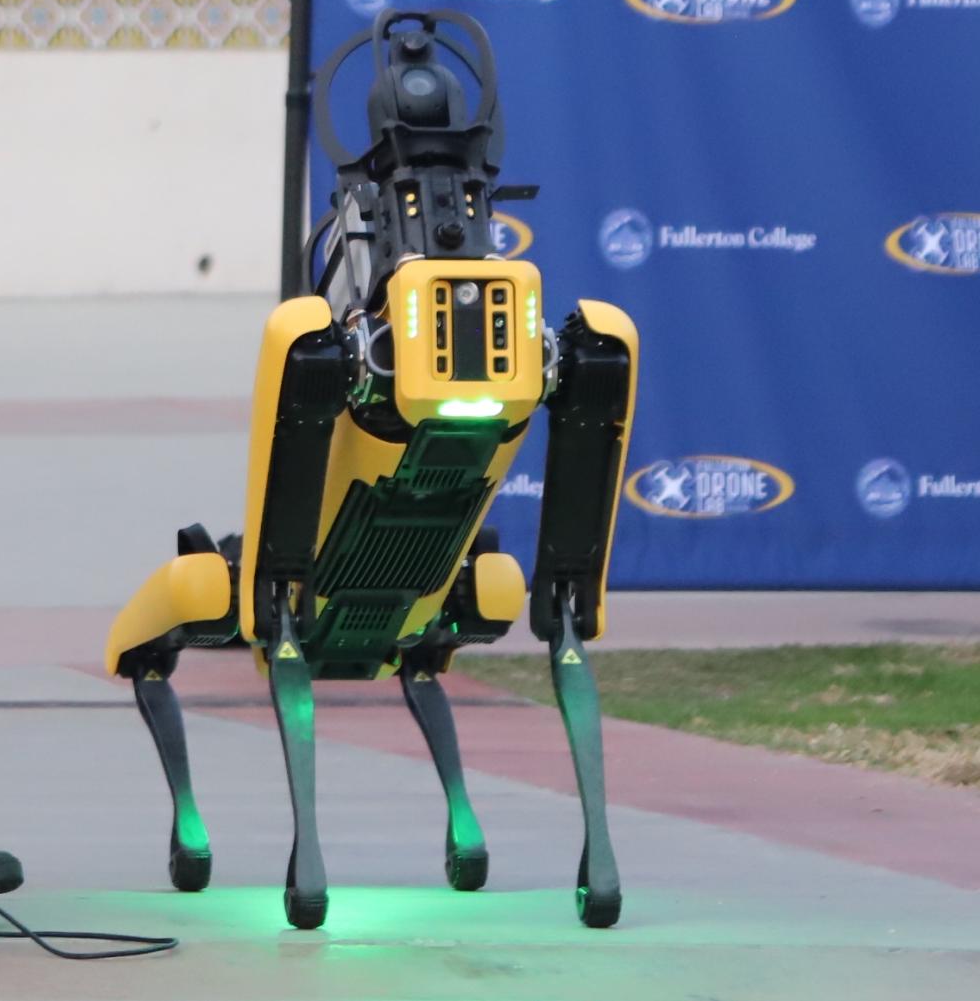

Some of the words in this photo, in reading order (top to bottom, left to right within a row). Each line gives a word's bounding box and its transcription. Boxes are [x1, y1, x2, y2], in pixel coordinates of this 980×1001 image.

[660, 226, 745, 249] Fullerton
[748, 227, 817, 252] College
[696, 471, 768, 500] DRONE
